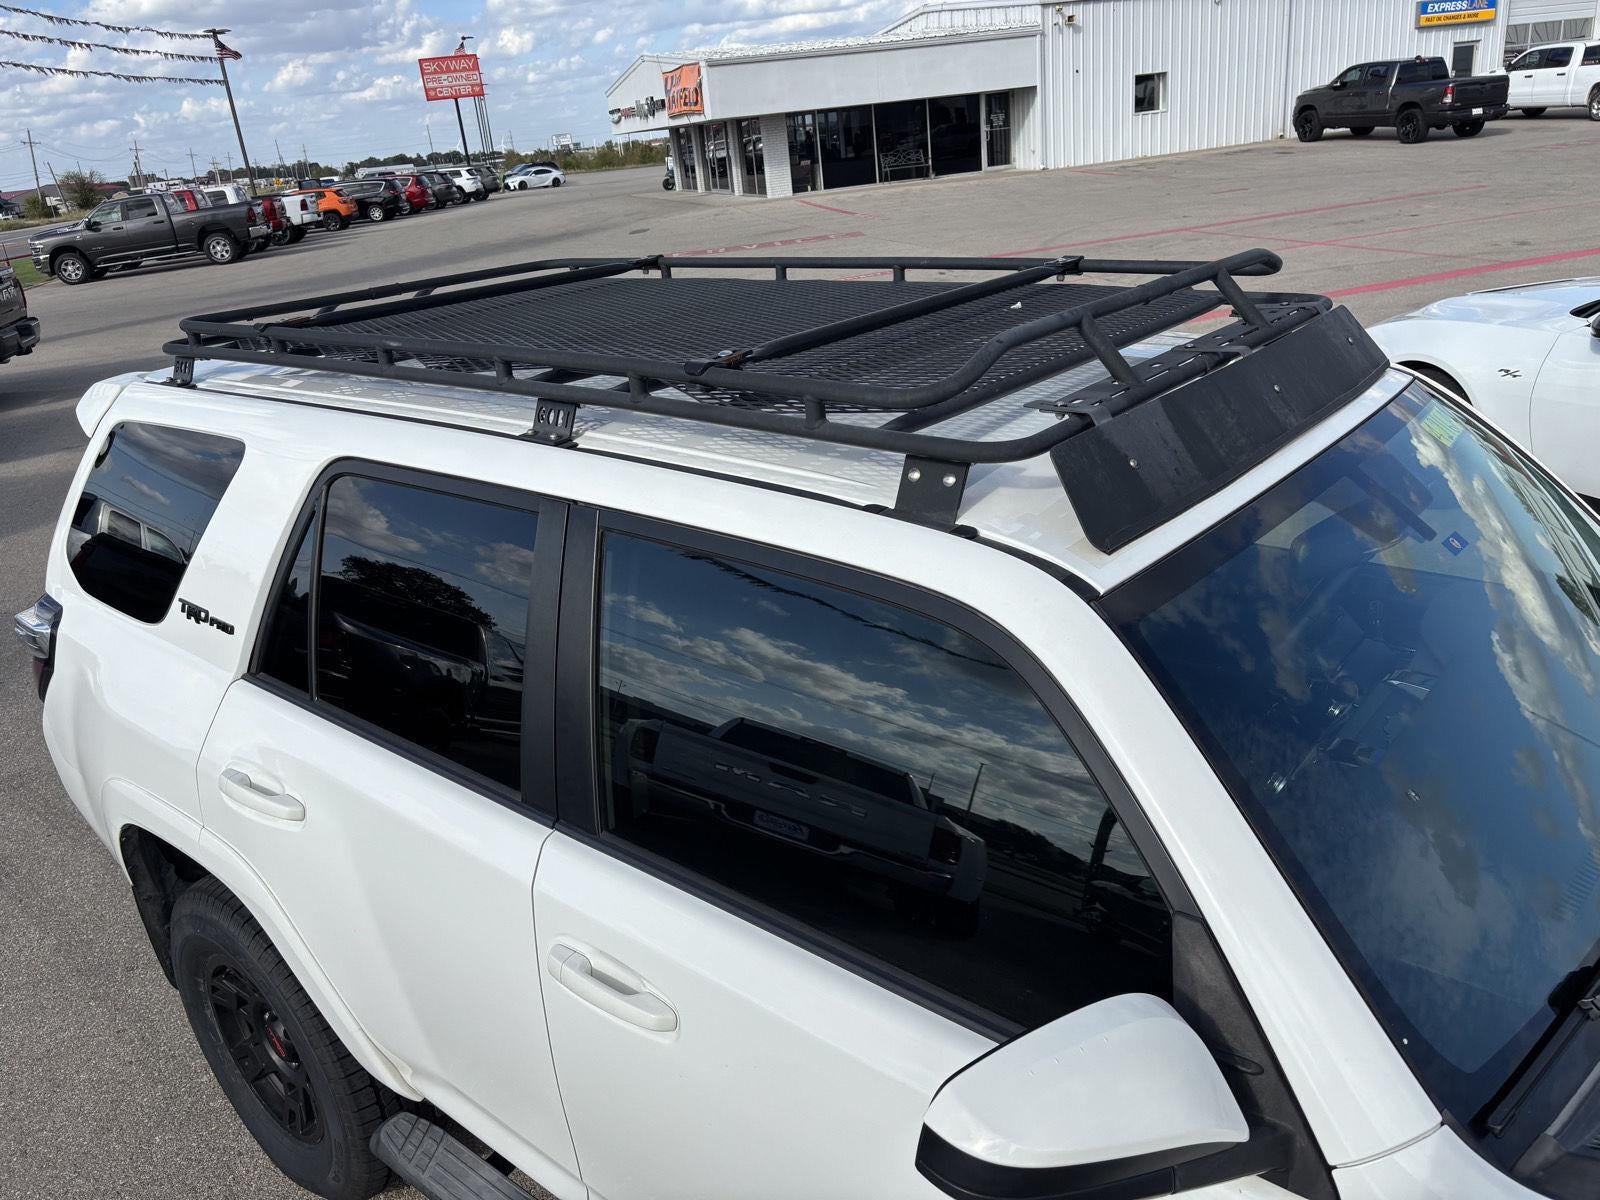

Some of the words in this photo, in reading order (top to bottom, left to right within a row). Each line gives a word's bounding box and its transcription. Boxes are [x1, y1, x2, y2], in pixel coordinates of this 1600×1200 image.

[422, 59, 474, 73] SKYWAY
[425, 73, 478, 85] PRE-OWNED
[436, 86, 473, 97] CENTER
